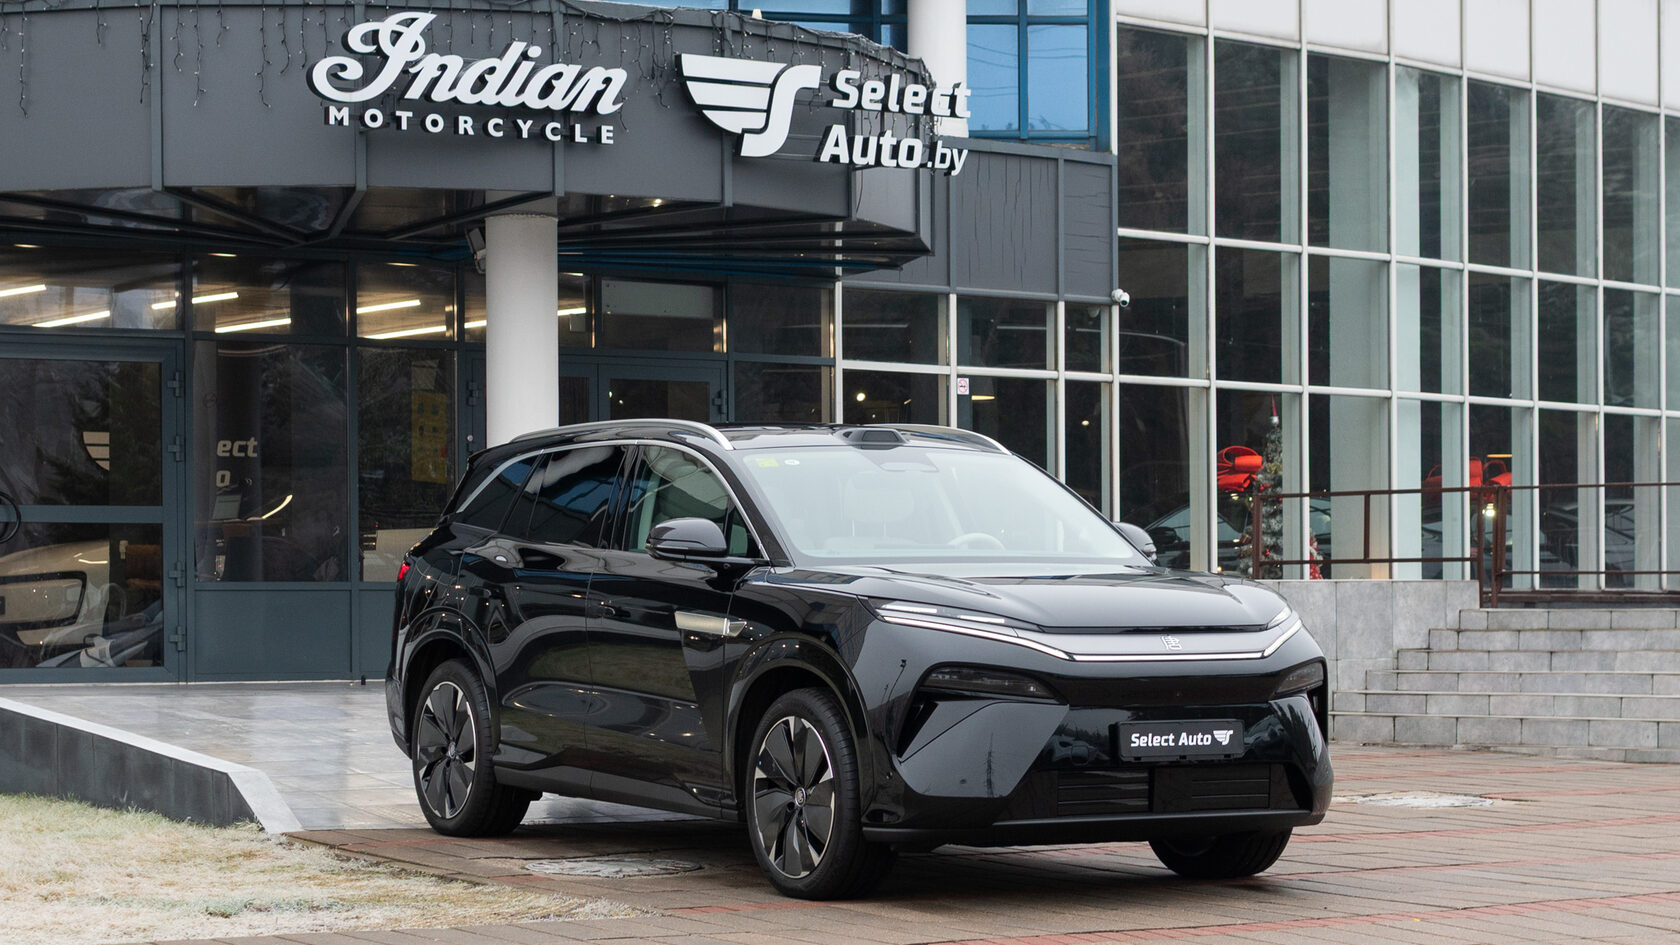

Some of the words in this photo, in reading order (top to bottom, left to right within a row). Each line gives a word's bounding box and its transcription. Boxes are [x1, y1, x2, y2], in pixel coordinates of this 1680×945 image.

[310, 11, 628, 115] Indian
[831, 69, 971, 118] Select
[328, 106, 614, 144] MOTORCYCLE
[216, 436, 258, 457] ect
[1130, 733, 1175, 747] Select
[1178, 732, 1212, 746] Auto
